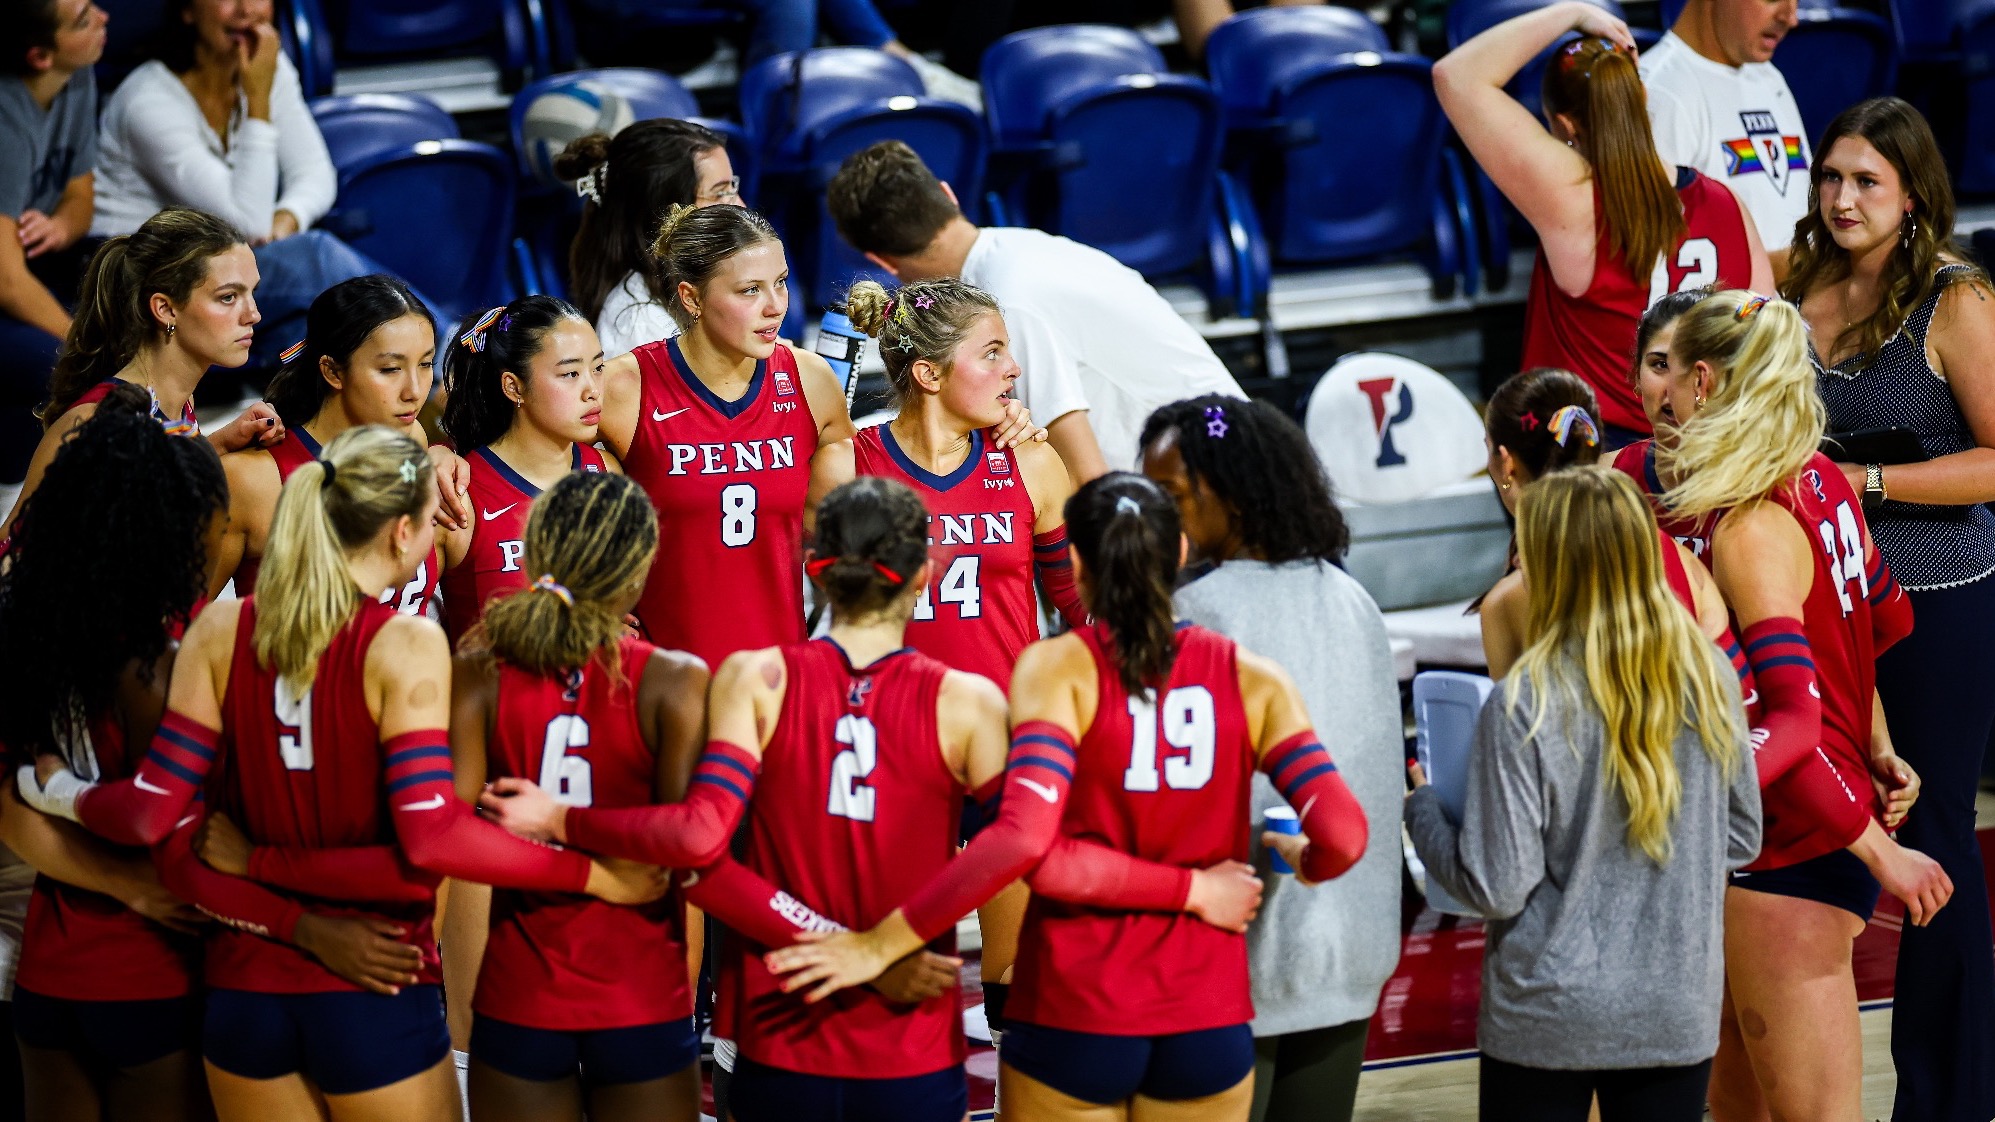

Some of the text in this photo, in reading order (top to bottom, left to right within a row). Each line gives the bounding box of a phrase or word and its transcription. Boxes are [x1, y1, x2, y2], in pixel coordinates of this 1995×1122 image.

[772, 401, 791, 413] Ivy
[667, 436, 795, 475] PENN
[983, 478, 1004, 490] Ivy
[721, 482, 757, 549] 8
[1818, 499, 1870, 618] 24
[274, 673, 314, 770] 9
[538, 713, 593, 809] 6
[828, 713, 877, 823] 2
[1123, 684, 1217, 793] 19
